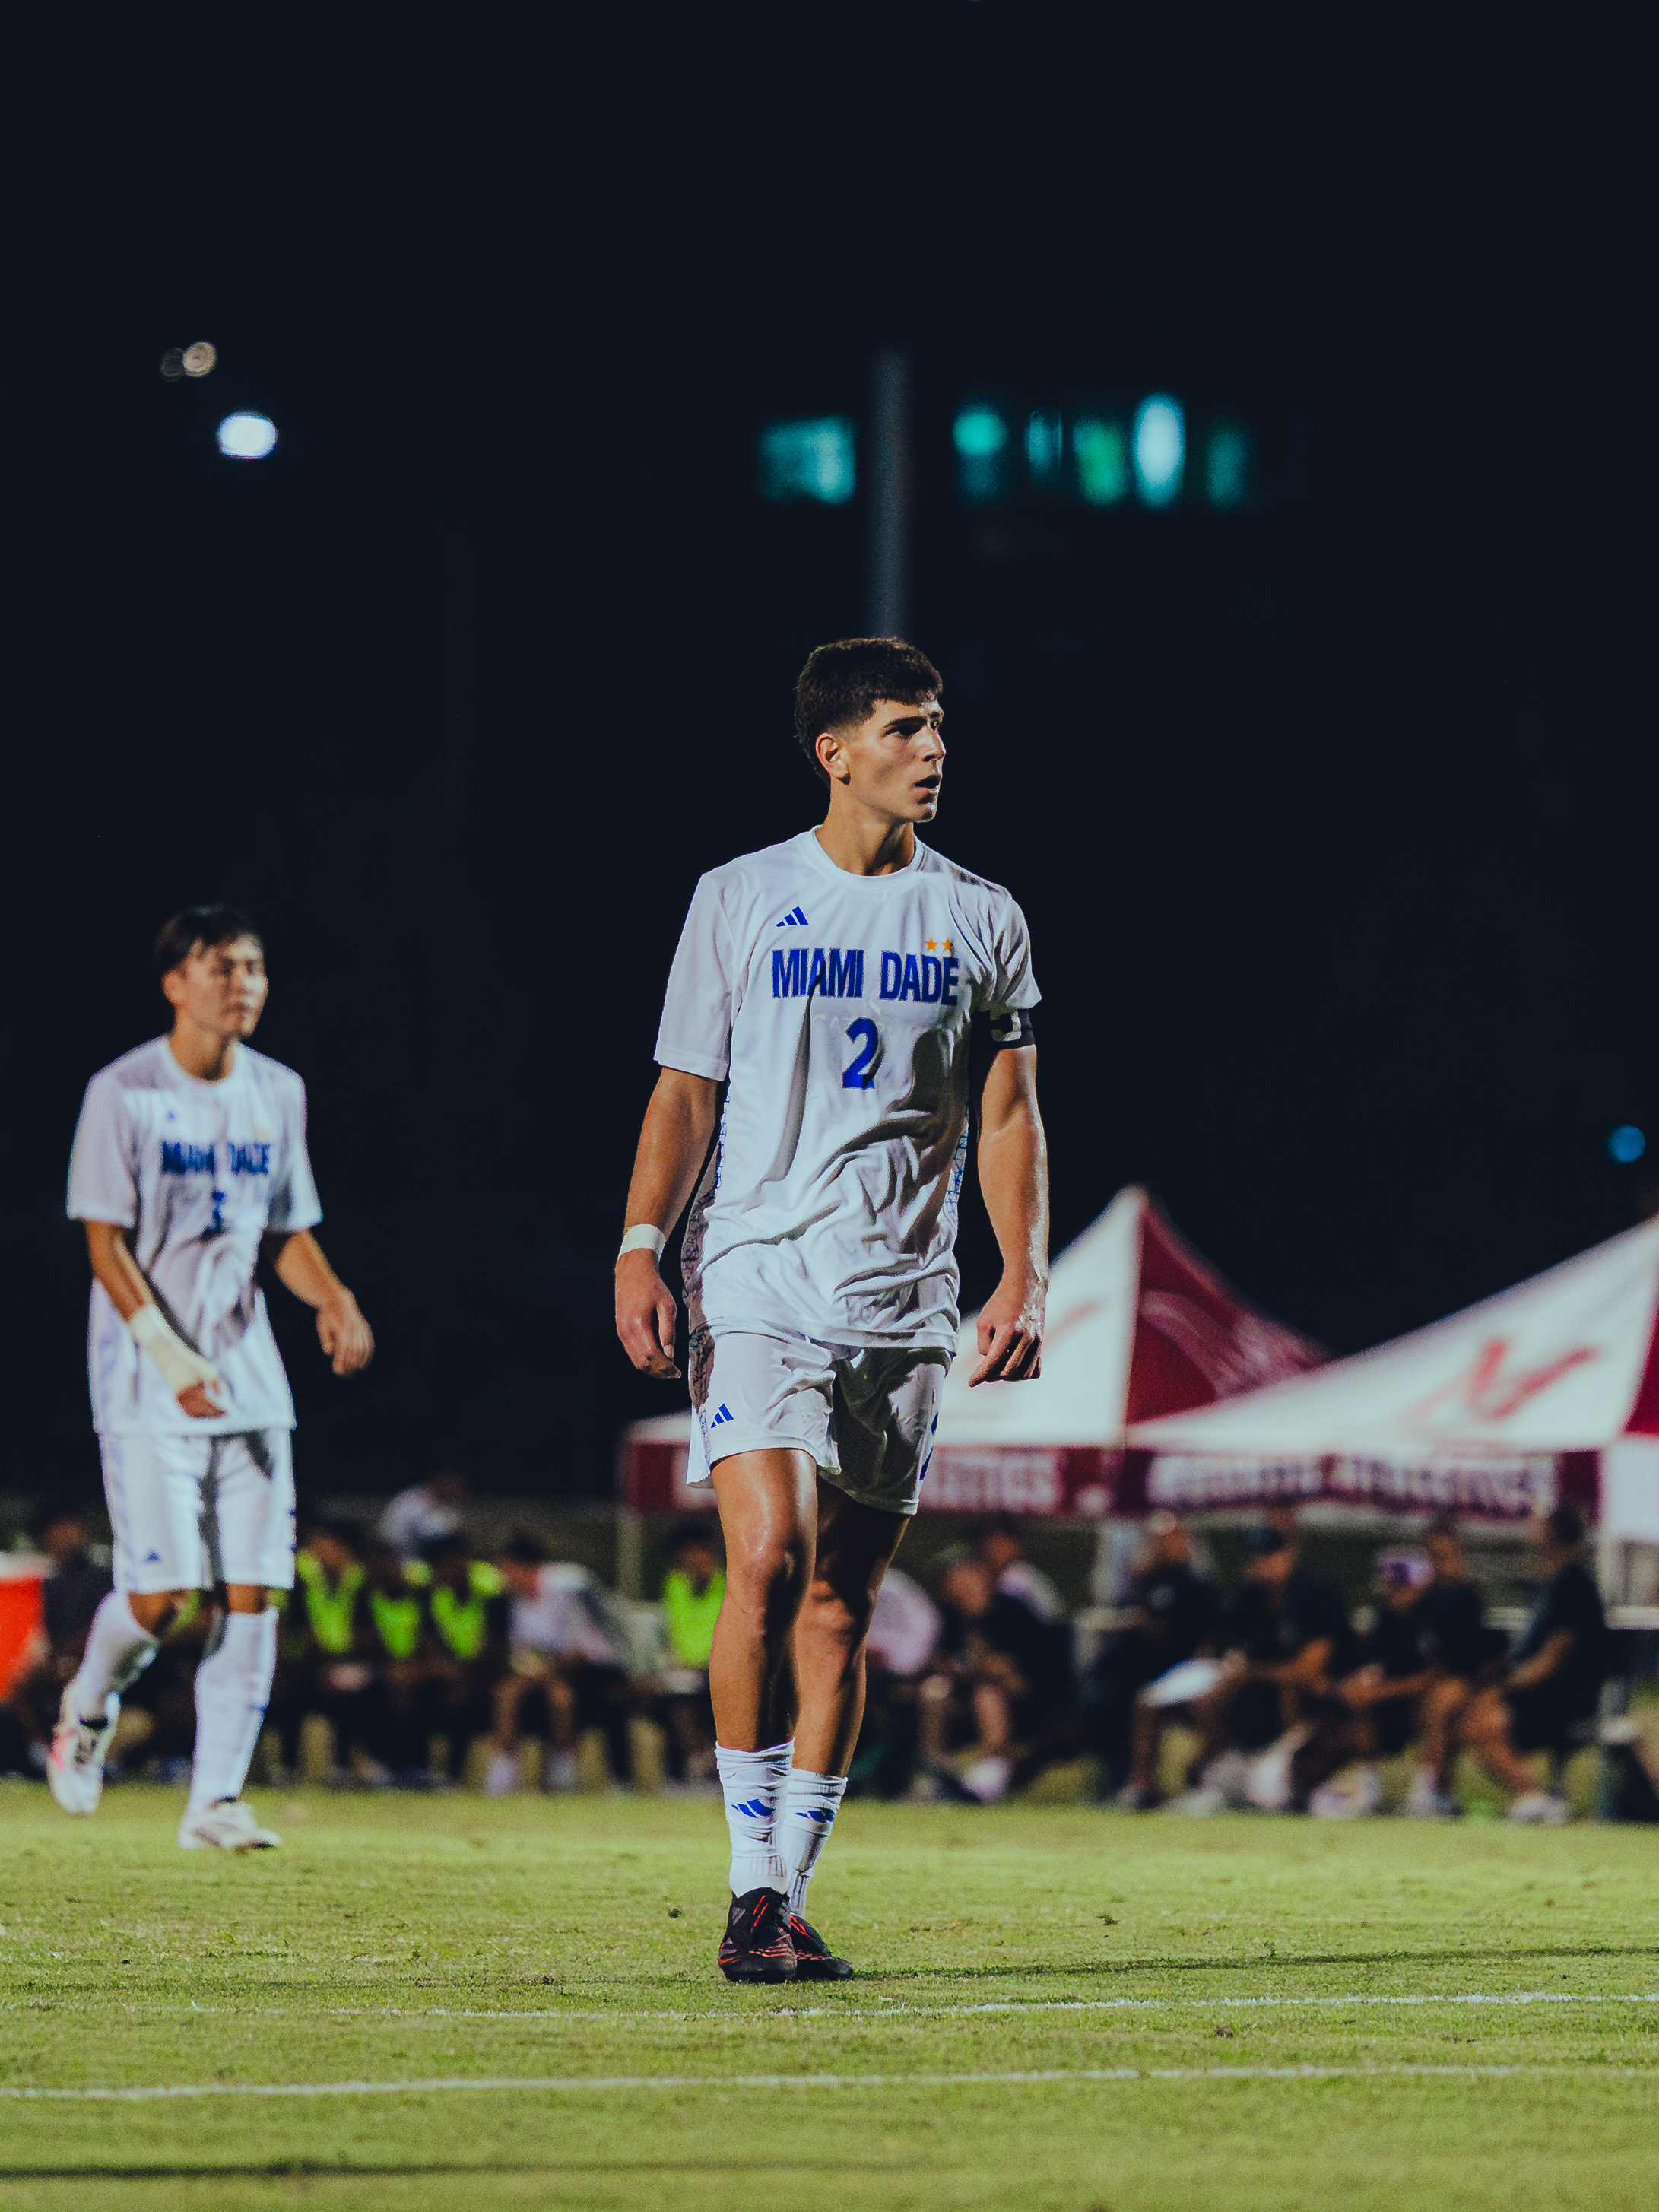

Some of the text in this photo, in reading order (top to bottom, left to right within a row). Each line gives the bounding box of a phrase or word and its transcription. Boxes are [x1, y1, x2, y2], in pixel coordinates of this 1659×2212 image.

[772, 948, 959, 1005] MIAMI DADE
[842, 1017, 880, 1090] 2
